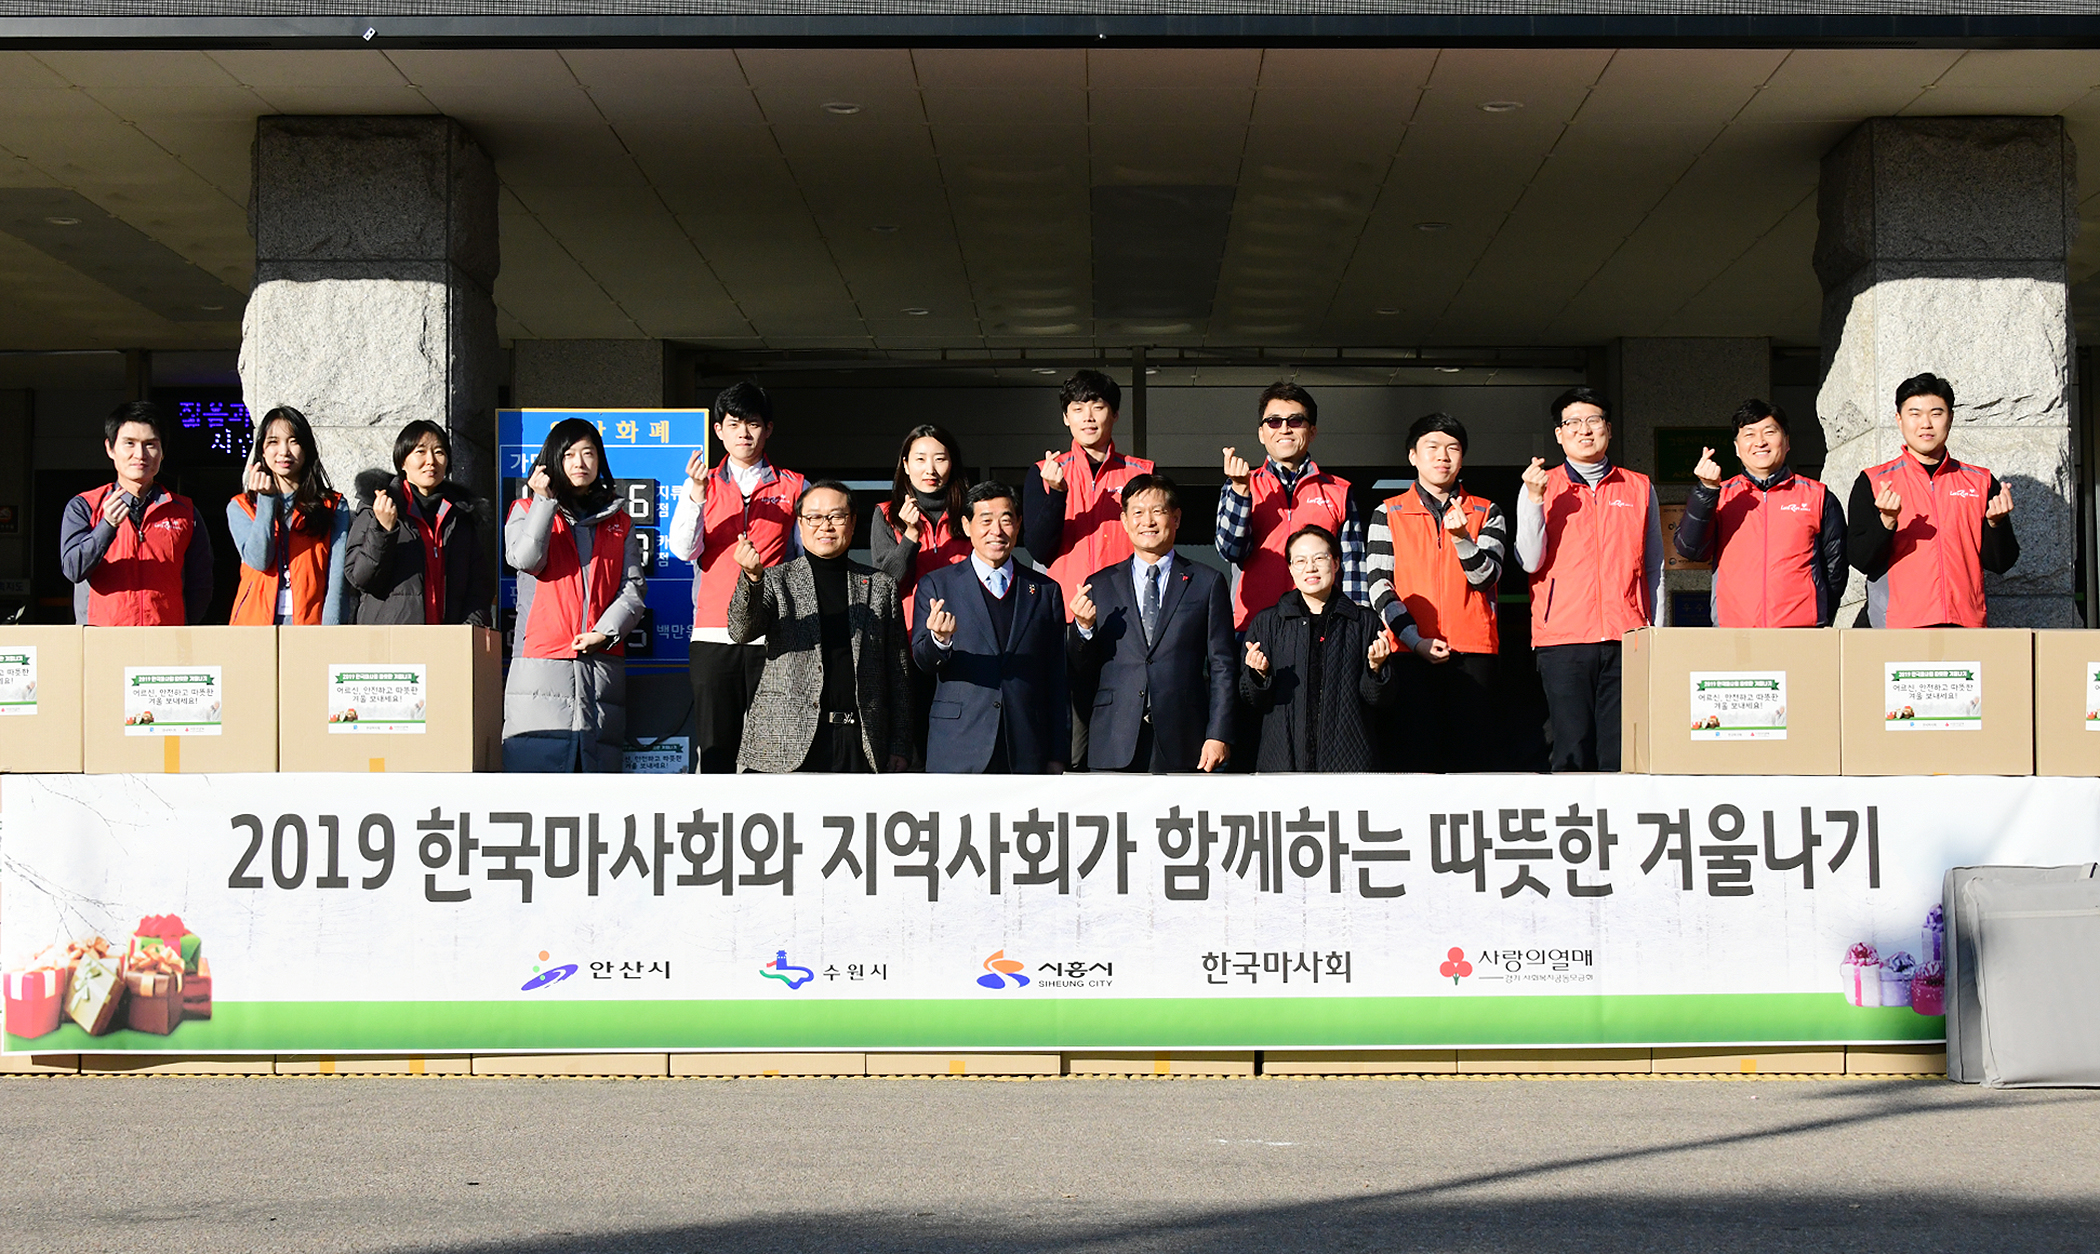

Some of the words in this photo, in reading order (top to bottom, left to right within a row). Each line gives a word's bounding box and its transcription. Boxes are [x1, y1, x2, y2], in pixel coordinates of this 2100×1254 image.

[228, 813, 395, 890] 2019
[416, 806, 803, 904] 한국마사회와
[821, 807, 1137, 902] 지역사회가
[1155, 805, 1411, 901] 함께하는
[1430, 802, 1619, 899] 따뜻한
[1637, 803, 1880, 897] 겨울나기
[589, 960, 670, 980] 안산시
[1038, 961, 1113, 979] 시흥시
[1201, 950, 1352, 985] 한국마사회
[1478, 949, 1593, 973] 사랑의열매
[823, 963, 887, 982] 수원시
[1038, 980, 1085, 988] SIHEUNG
[1088, 980, 1113, 988] CITY
